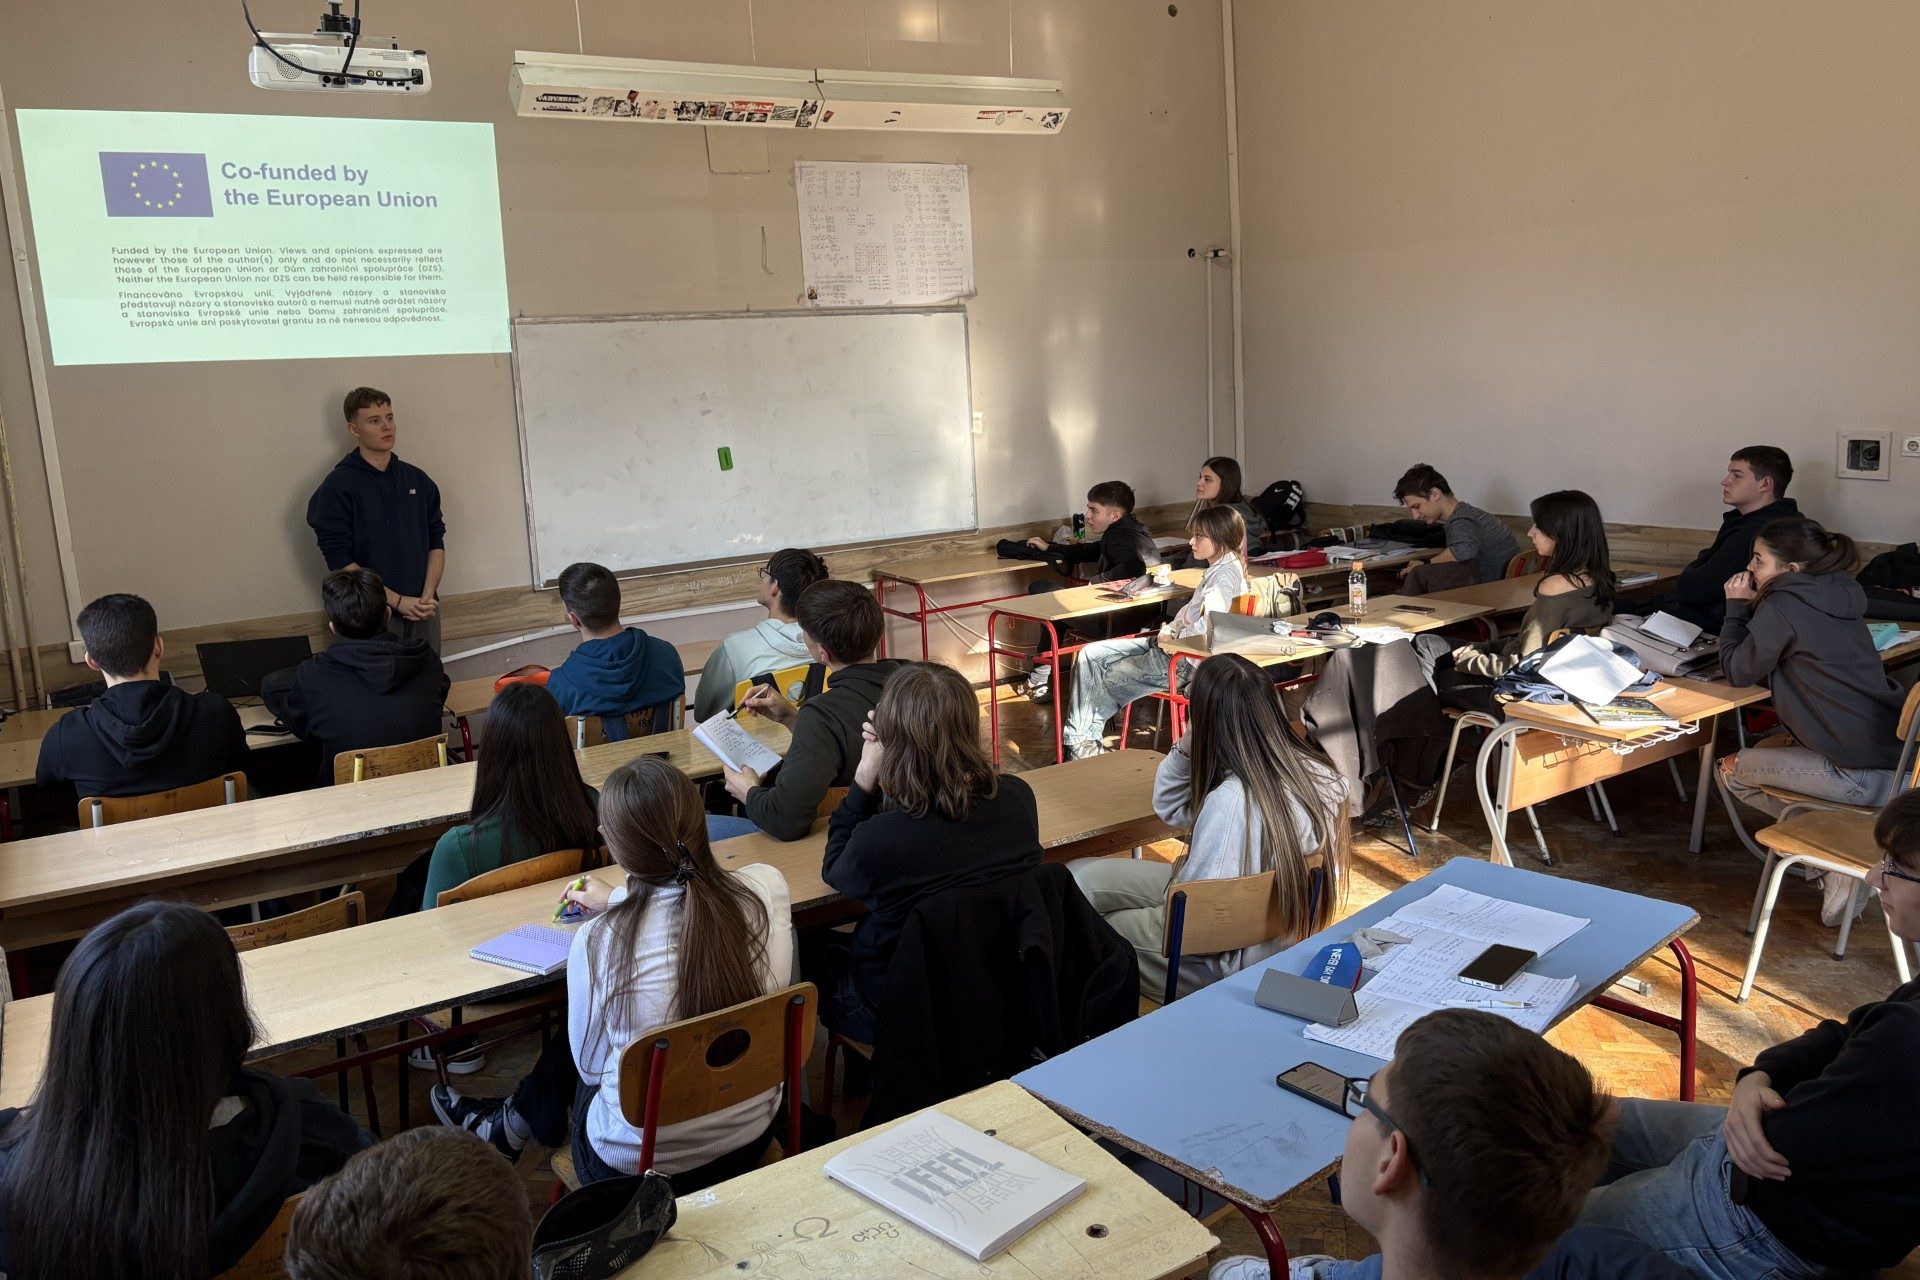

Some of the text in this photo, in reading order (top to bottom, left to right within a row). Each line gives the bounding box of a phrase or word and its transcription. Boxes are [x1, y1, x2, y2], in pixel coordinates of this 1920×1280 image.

[221, 162, 369, 186] Co-funded by
[224, 189, 438, 212] the European Union
[112, 247, 149, 255] Funded
[154, 247, 166, 256] by
[194, 247, 240, 256] European
[279, 247, 306, 255] Views
[335, 247, 374, 256] opinions
[378, 247, 423, 256] expressed
[113, 256, 155, 264] however
[160, 256, 188, 264] those
[193, 256, 203, 264] of
[207, 256, 223, 264] the
[228, 255, 273, 264] author(s)
[278, 256, 298, 265] only
[302, 256, 321, 264] and
[325, 256, 337, 264] do
[341, 256, 357, 264] not
[361, 256, 411, 265] necessarily
[114, 266, 142, 274] those
[148, 266, 158, 274] of
[185, 266, 231, 275] European
[157, 275, 173, 283] the
[176, 275, 222, 284] European
[273, 274, 290, 282] DZS
[327, 274, 348, 282] held
[350, 274, 401, 283] responsible
[404, 274, 416, 282] for
[194, 290, 244, 299] Evropskou
[400, 288, 446, 296] stanoviska
[223, 299, 274, 307] stanoviska
[137, 310, 190, 318] stanoviska
[249, 308, 269, 316] unie
[177, 319, 198, 327] unie
[201, 318, 217, 326] ani
[219, 318, 280, 327] poskytovatel
[282, 318, 314, 327] grantu
